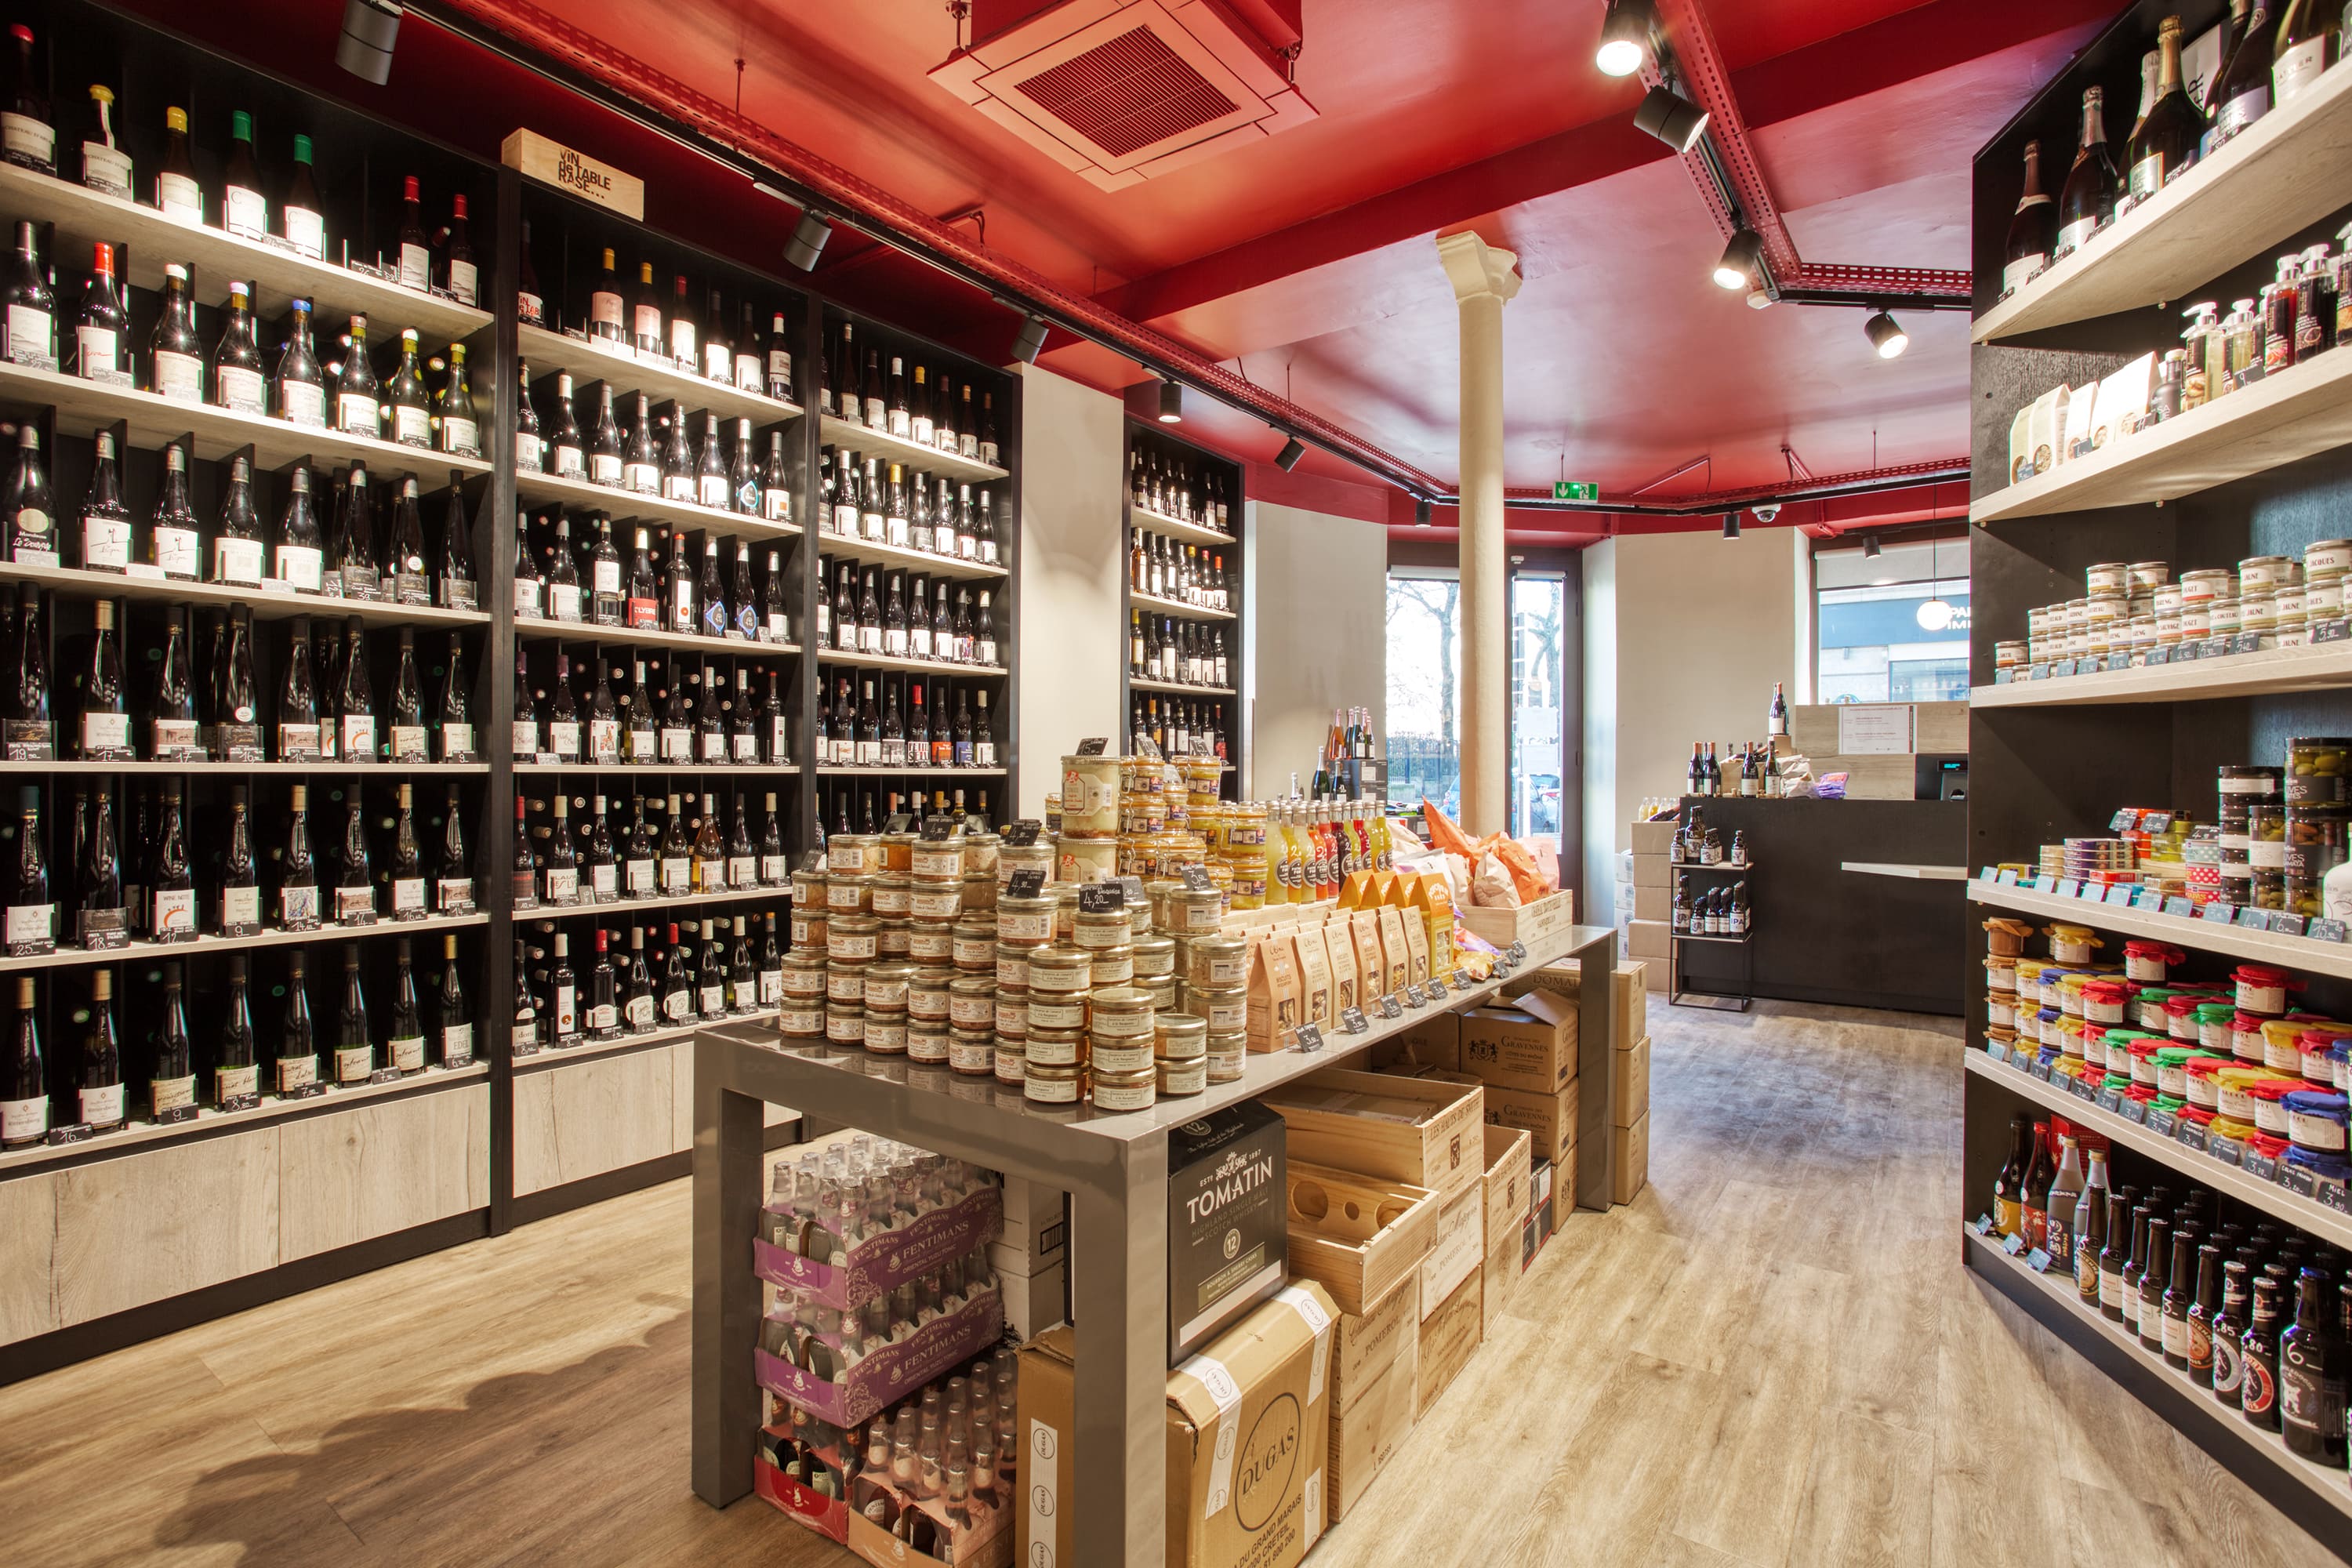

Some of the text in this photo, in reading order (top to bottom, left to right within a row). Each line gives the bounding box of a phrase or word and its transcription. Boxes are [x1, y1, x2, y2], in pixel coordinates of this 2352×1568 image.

[2309, 557, 2335, 567] JACQUES
[1533, 974, 1581, 988] DOMAI
[1430, 1125, 1439, 1142] LES
[1440, 1115, 1457, 1134] HAUTS
[1465, 1098, 1480, 1118] SMITH
[1503, 1104, 1551, 1122] GRAVENNES
[1249, 1149, 1261, 1160] 1897
[1186, 1156, 1272, 1224] TOMATIN
[909, 1214, 949, 1236] FENTIMANS
[854, 1236, 899, 1261] FENTIMANS
[903, 1220, 969, 1259] FENTIMANS
[1227, 1236, 1236, 1252] 12
[905, 1325, 971, 1370] FENTIMANS
[911, 1320, 951, 1348] FENTIMANS
[1365, 1317, 1400, 1357] POMEROL
[854, 1349, 899, 1377] FENTIMANS
[1243, 1427, 1294, 1495] DUGAS
[1251, 1523, 1276, 1555] GRAND
[1277, 1493, 1302, 1524] MARAIS
[1262, 1522, 1290, 1558] CRETEIL
